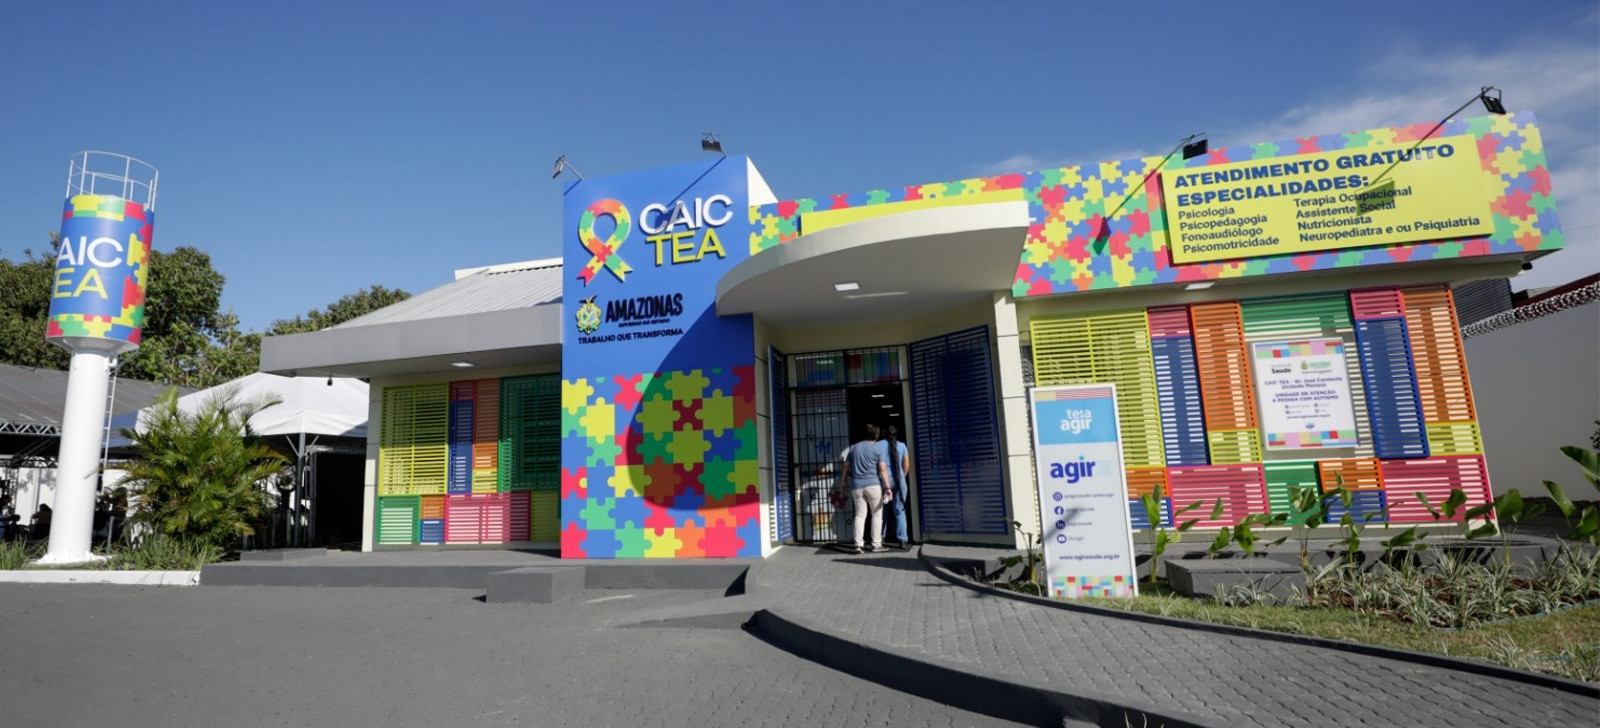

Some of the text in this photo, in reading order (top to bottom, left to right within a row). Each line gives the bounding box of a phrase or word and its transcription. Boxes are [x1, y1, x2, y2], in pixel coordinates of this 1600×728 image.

[1175, 144, 1454, 188] ATENDIMENTO GRATUITO
[1177, 174, 1369, 207] ESPECIALIDADES:
[1294, 186, 1412, 208] Terapia Ocupacional
[639, 194, 733, 235] CAIC
[1178, 206, 1235, 220] Psicologia
[1296, 200, 1396, 220] Assistente Social
[1180, 214, 1268, 231] Psicopedagogia
[1181, 227, 1263, 242] Fonoaudiólogo
[1297, 215, 1372, 231] Nutricionista
[1299, 216, 1480, 243] Neuropediatra e ou Psiquiatria
[56, 236, 123, 268] AIC
[646, 228, 727, 266] TEA
[1183, 236, 1280, 254] Psicomotricidade
[54, 267, 109, 299] EA
[605, 292, 684, 323] AMAZONAS
[578, 328, 684, 345] TRABALHO QUE TRANSFORMA
[1060, 418, 1093, 435] agir
[1050, 455, 1096, 484] agir
